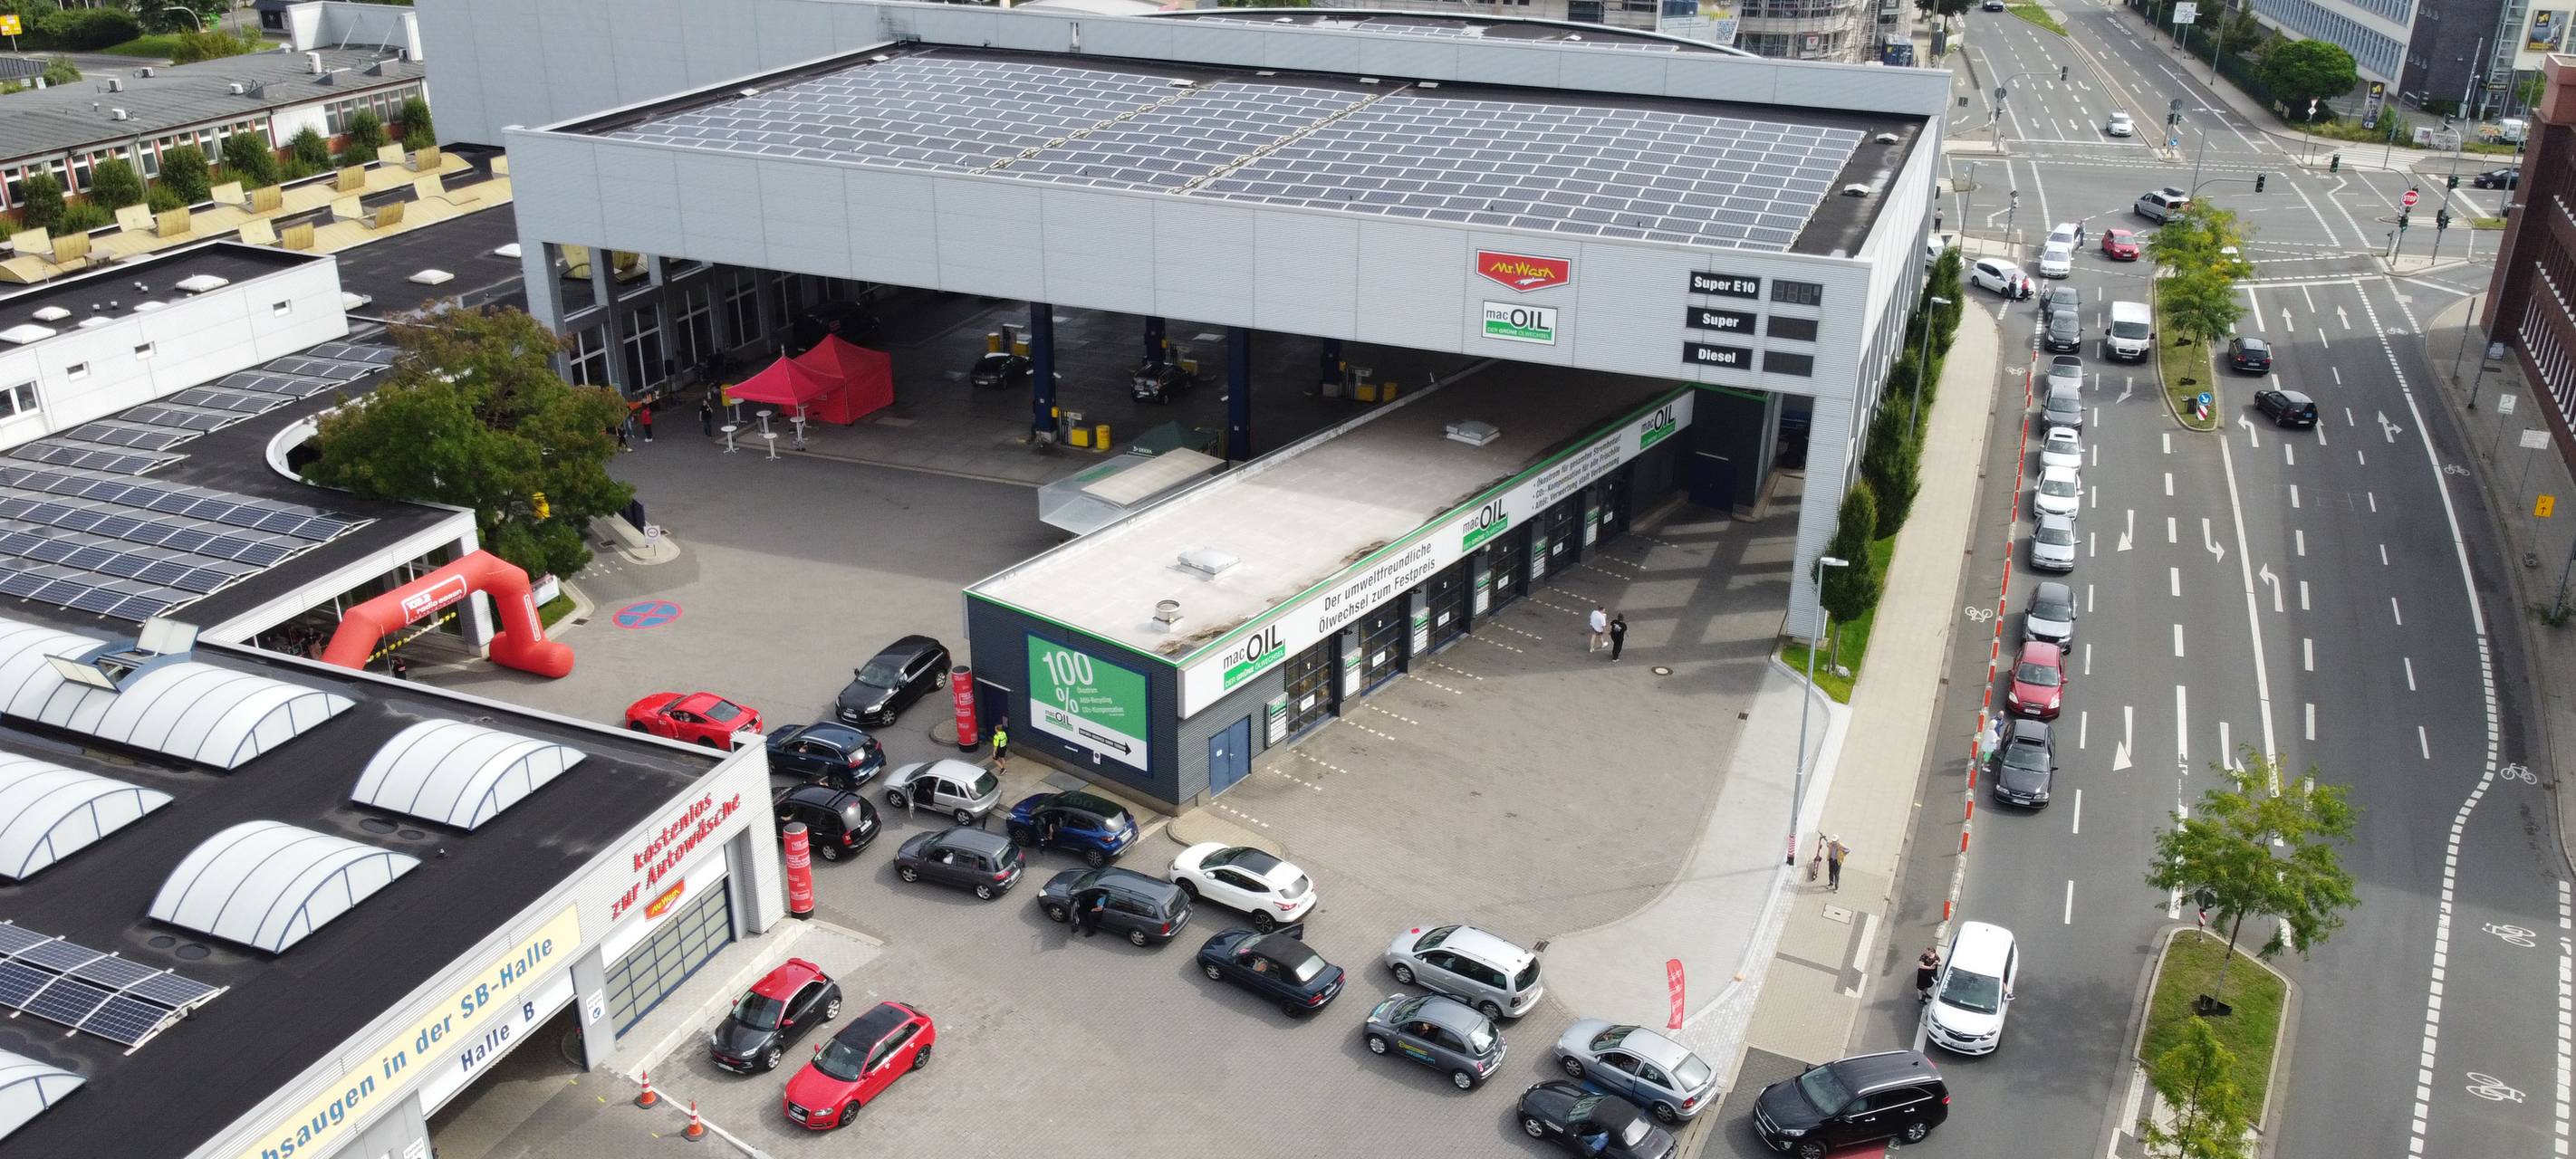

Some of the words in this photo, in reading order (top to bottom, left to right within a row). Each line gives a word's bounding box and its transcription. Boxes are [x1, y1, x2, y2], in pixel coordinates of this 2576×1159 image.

[1694, 276, 1731, 291] Super
[1733, 281, 1756, 293] E10
[1697, 349, 1736, 363] Diesel
[1702, 313, 1740, 328] Super
[1319, 594, 1369, 634] Ölwechsel
[1371, 584, 1391, 604] zum
[1395, 558, 1436, 590] Festpreis
[1324, 593, 1342, 612] Der
[1344, 542, 1432, 600] umweltfreundliche
[1042, 651, 1093, 685] 100
[611, 881, 641, 922] zur
[646, 792, 741, 891] Autowäsche
[634, 791, 712, 873] kostenlos
[382, 1049, 408, 1080] in
[415, 1012, 453, 1056] der
[459, 937, 553, 1020] SB-Halle
[460, 1023, 511, 1074] Halle
[523, 1001, 535, 1023] B
